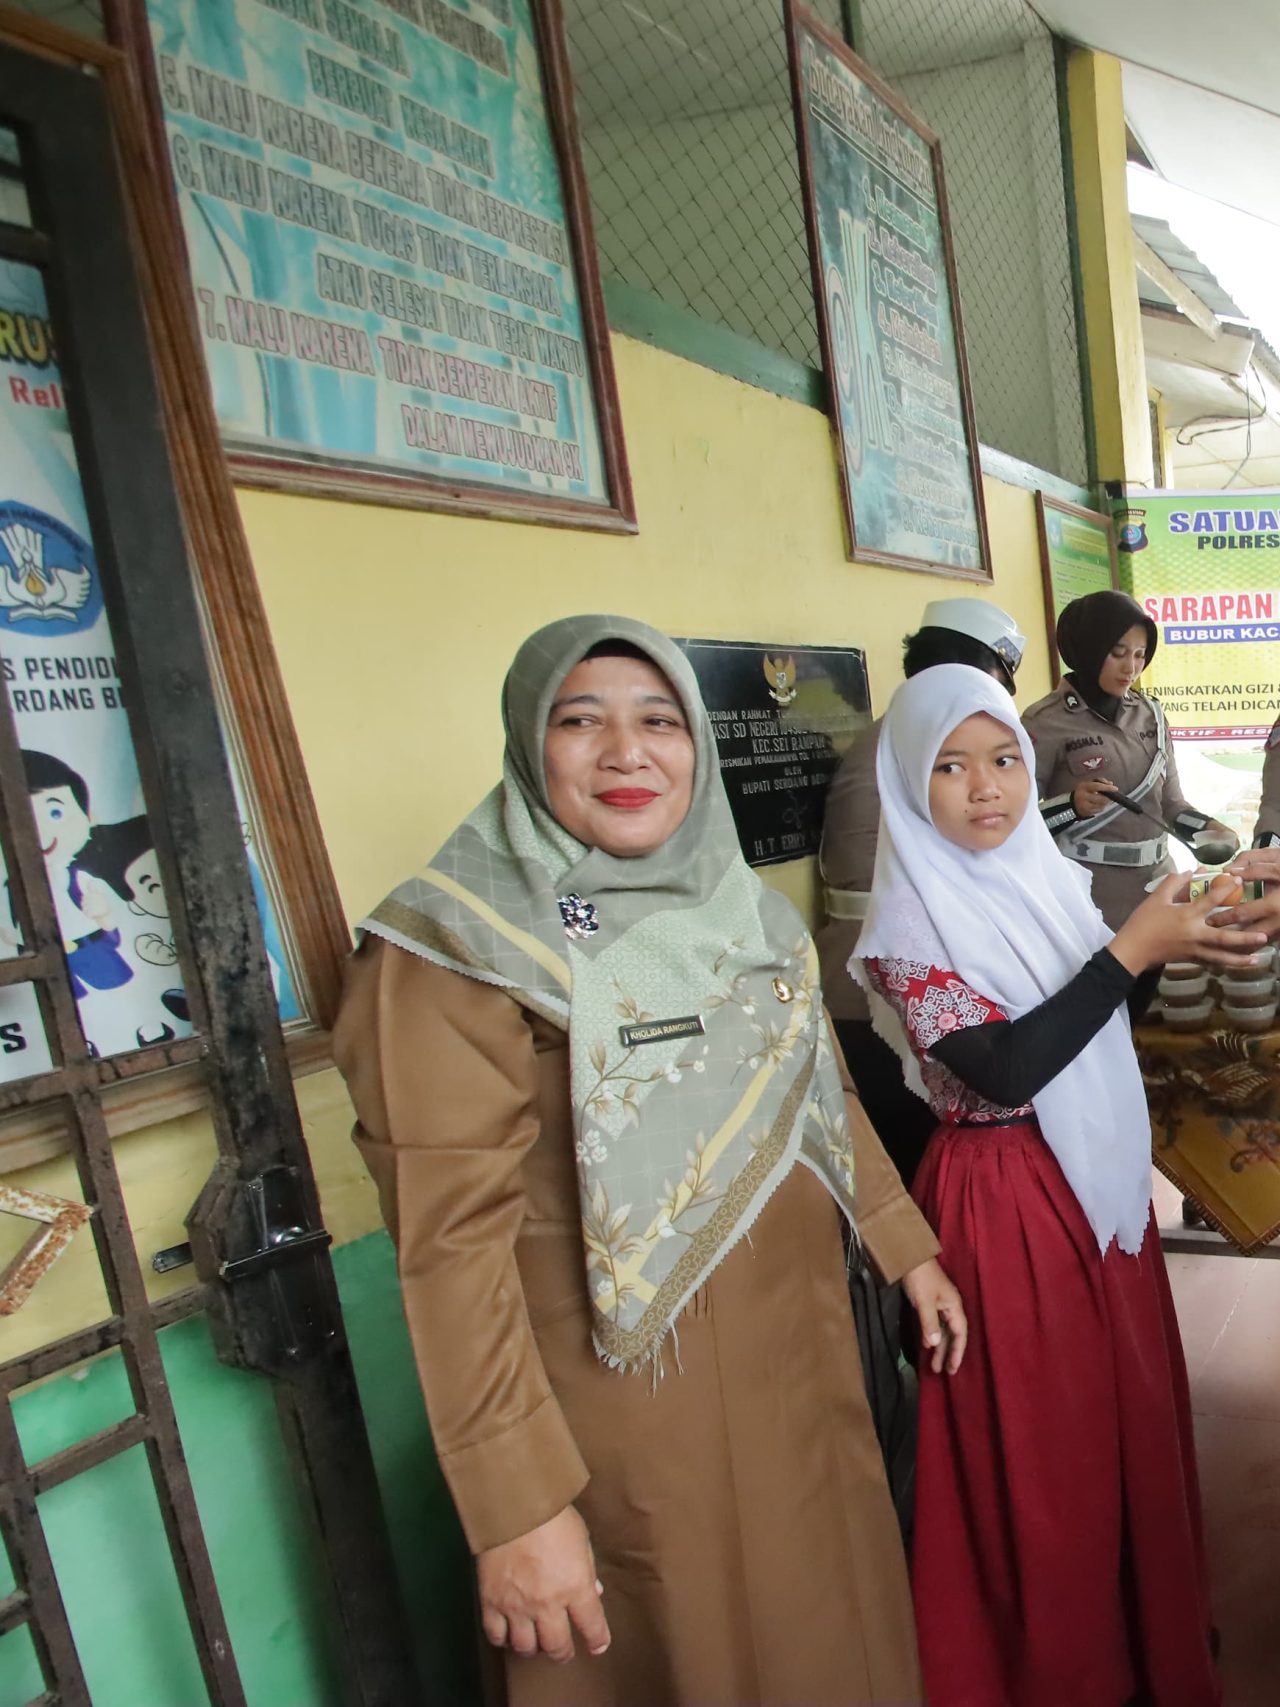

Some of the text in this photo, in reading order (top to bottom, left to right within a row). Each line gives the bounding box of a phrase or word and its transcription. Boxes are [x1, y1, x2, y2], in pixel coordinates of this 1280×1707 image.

[306, 48, 395, 131] BERBUAT
[159, 53, 568, 267] 5. MALU KARENA BEKERJA TIDAK BERPRESTASI
[172, 133, 562, 317] 6. MALU KARENA TUGAS TIDAK TERLAKSANA
[317, 252, 585, 378] ATAU SELESAI TIDAK TEPAT WAKTU
[198, 287, 558, 423] 7. MALU KARENA TIDAK BERPERAN AKTIF
[401, 403, 584, 481] DALAM MEWUJUDKAN 9K
[1198, 534, 1280, 550] POLRES
[1145, 593, 1272, 623] SARAPAN
[1170, 627, 1236, 641] BUBUR
[13, 687, 96, 713] RDANG
[1245, 683, 1274, 695] GIZI
[708, 711, 738, 721] DENGAN
[741, 709, 771, 720] RAHMAT
[1196, 700, 1238, 712] TELAH
[713, 723, 731, 739] ASI
[732, 722, 747, 738] SD
[750, 720, 779, 737] NEGERI
[742, 780, 771, 795] BUPATI
[629, 1021, 699, 1040] KHOLIDA RANGKUTI
